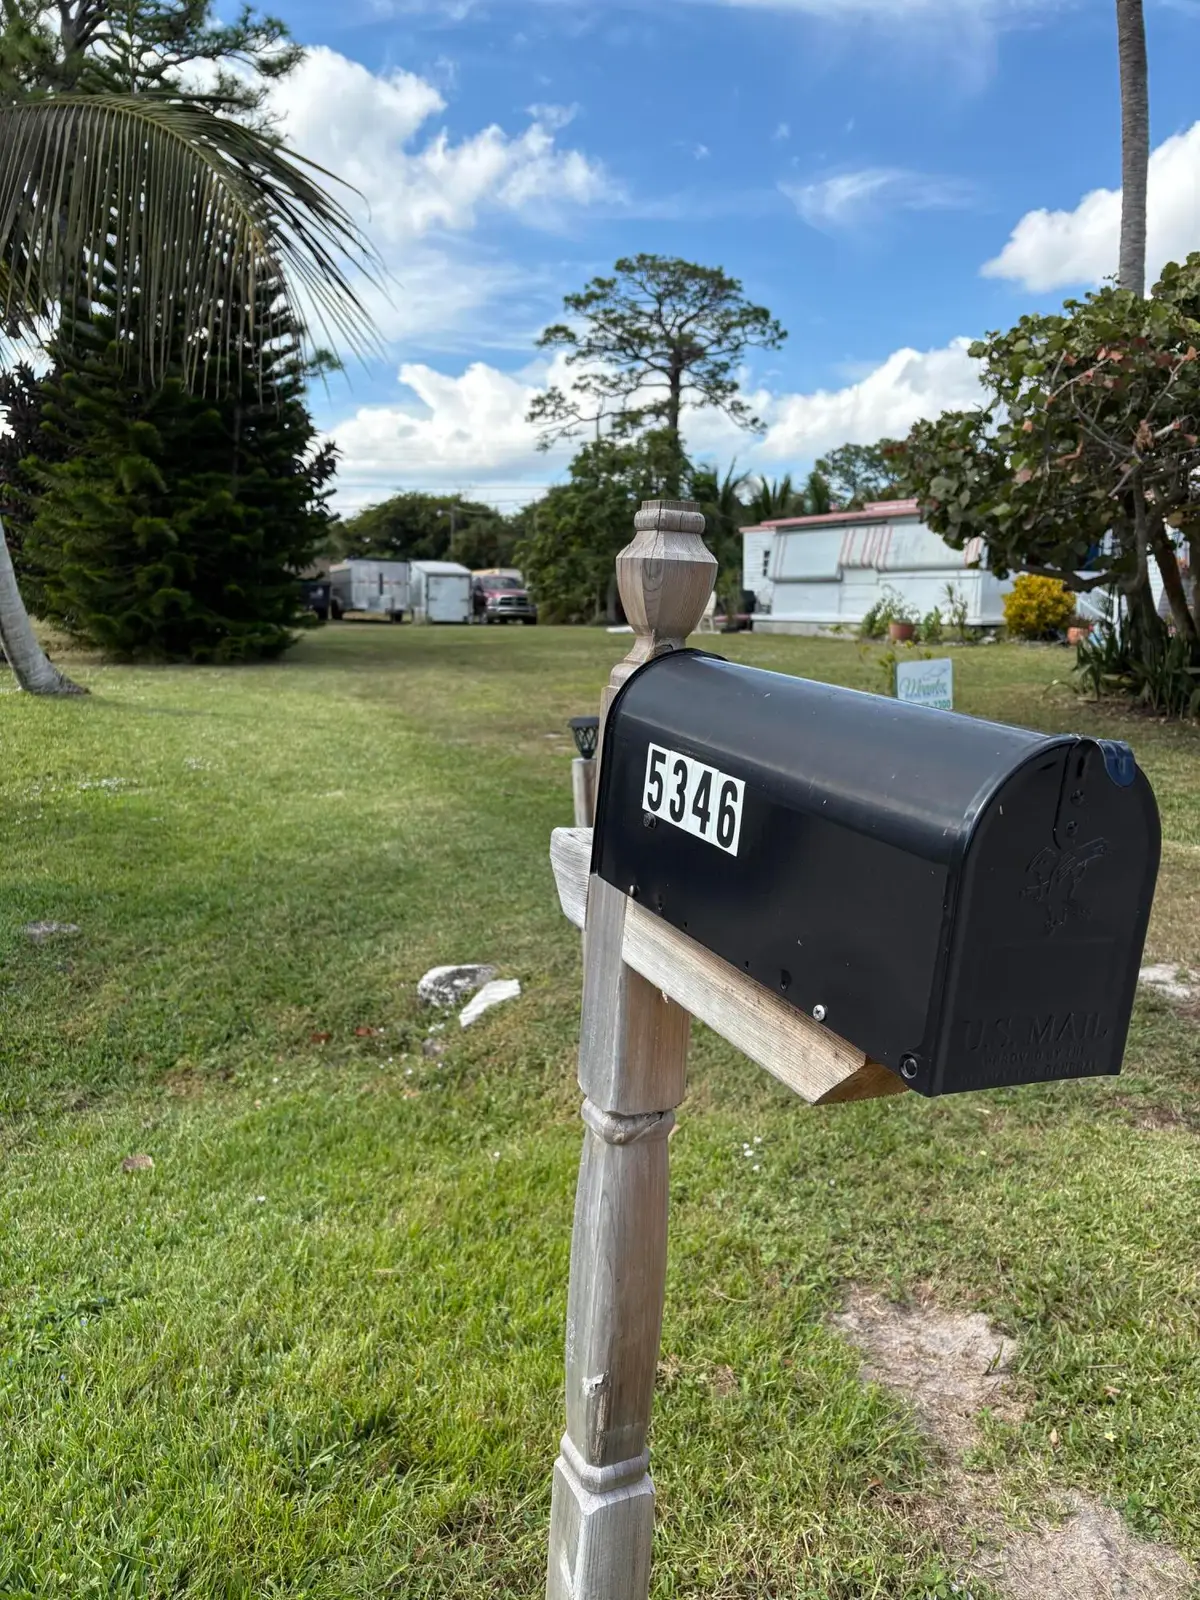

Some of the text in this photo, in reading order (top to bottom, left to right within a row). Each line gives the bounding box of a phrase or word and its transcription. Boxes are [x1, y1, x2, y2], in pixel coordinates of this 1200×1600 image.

[647, 749, 738, 849] 5346
[963, 1011, 1109, 1051] U.S. MAIL
